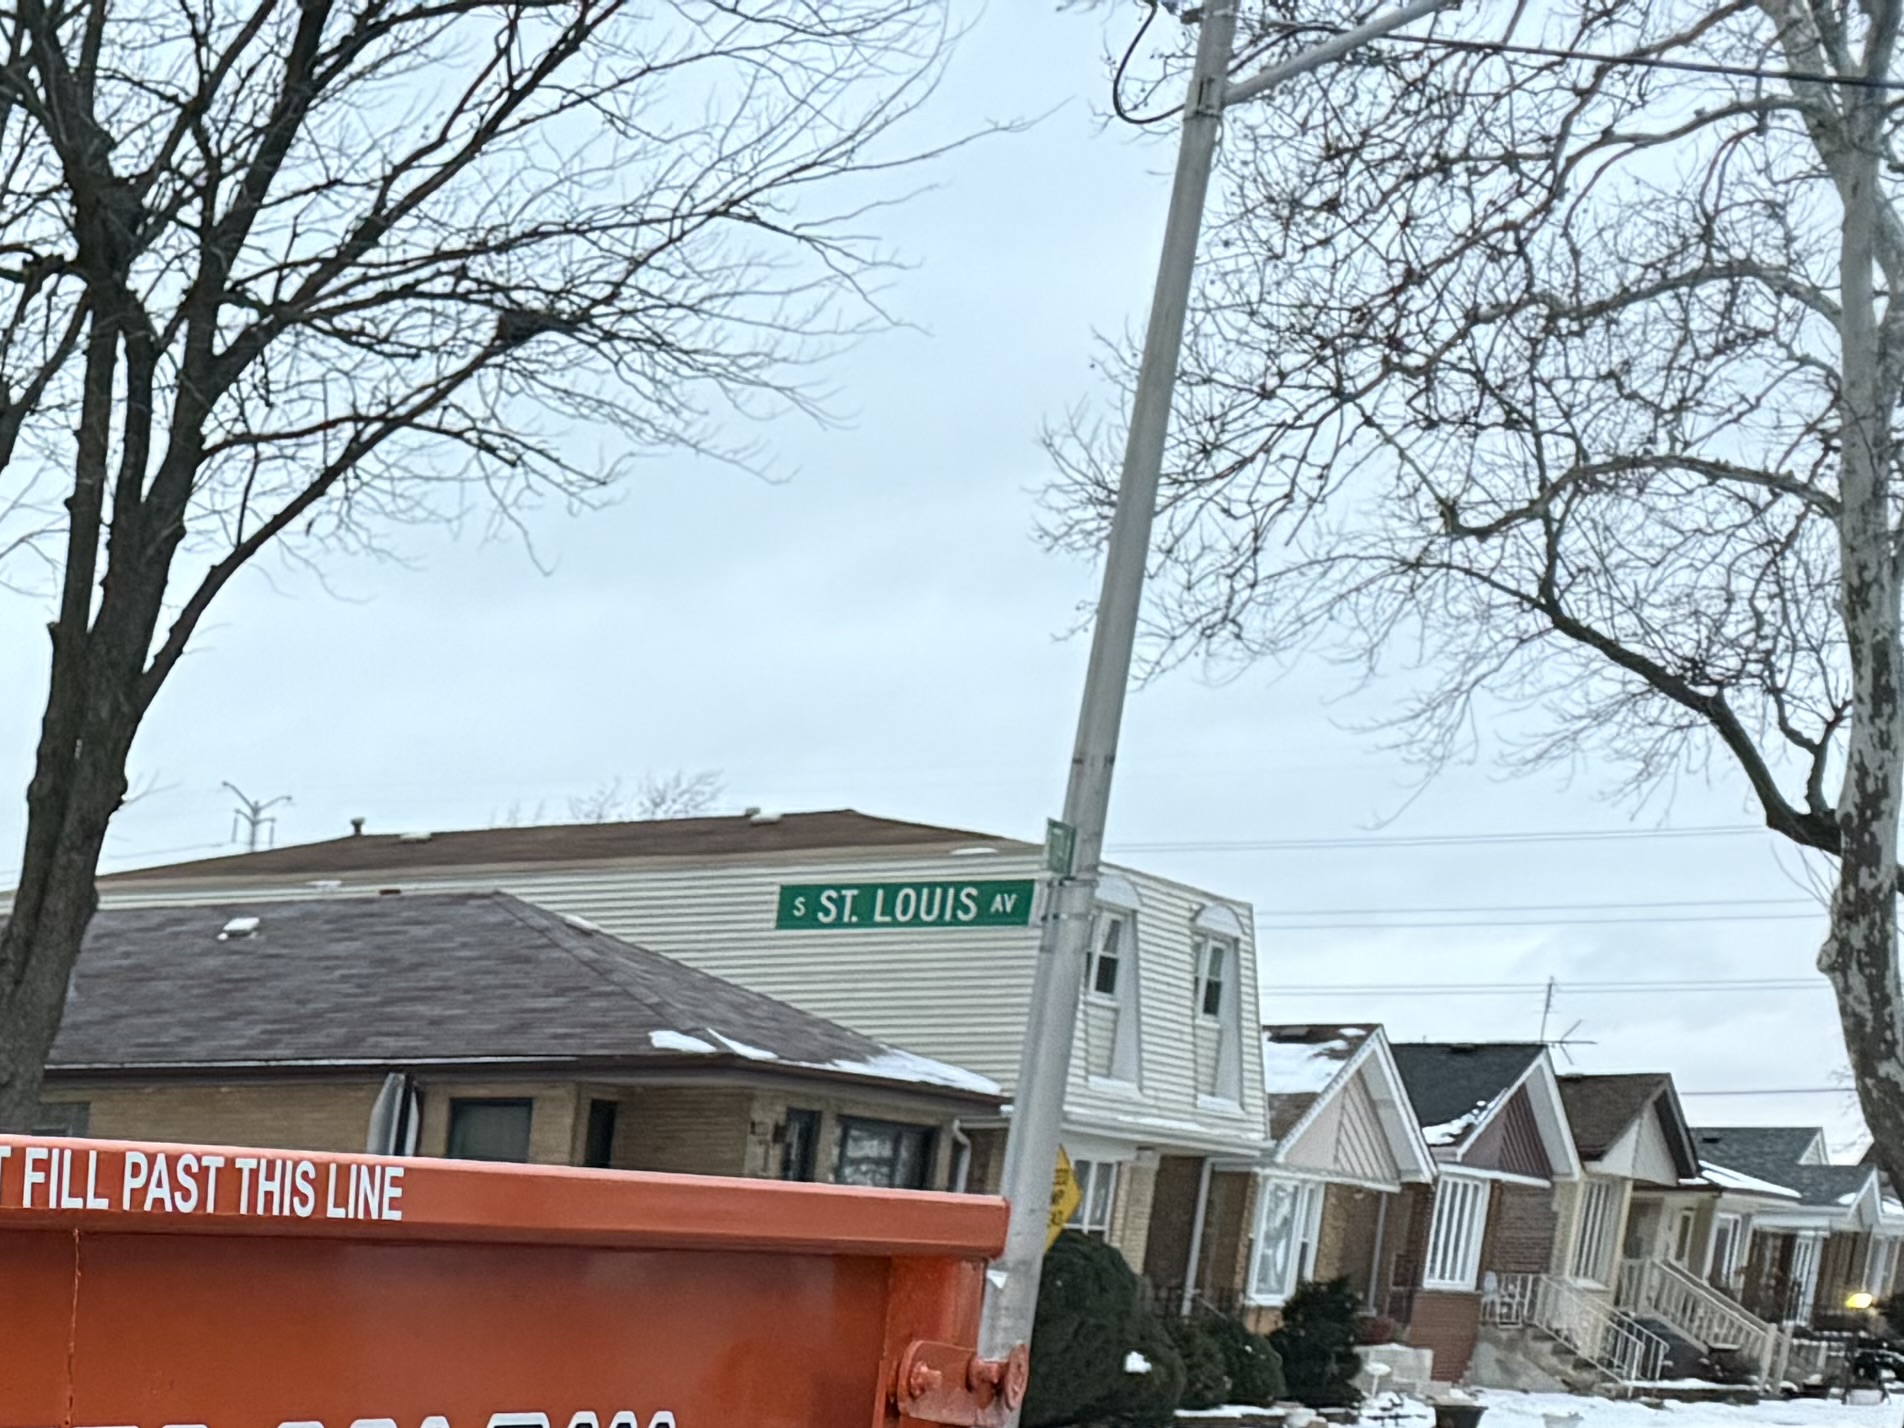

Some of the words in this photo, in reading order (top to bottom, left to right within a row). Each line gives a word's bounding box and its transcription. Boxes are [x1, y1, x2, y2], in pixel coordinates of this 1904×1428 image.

[793, 897, 806, 917] S
[817, 889, 859, 923] ST.
[873, 887, 979, 922] LOUIS
[990, 894, 1018, 913] AV
[23, 1147, 109, 1210] FILL
[122, 1151, 225, 1214] PAST
[235, 1157, 316, 1218] THIS
[326, 1163, 404, 1221] LINE
